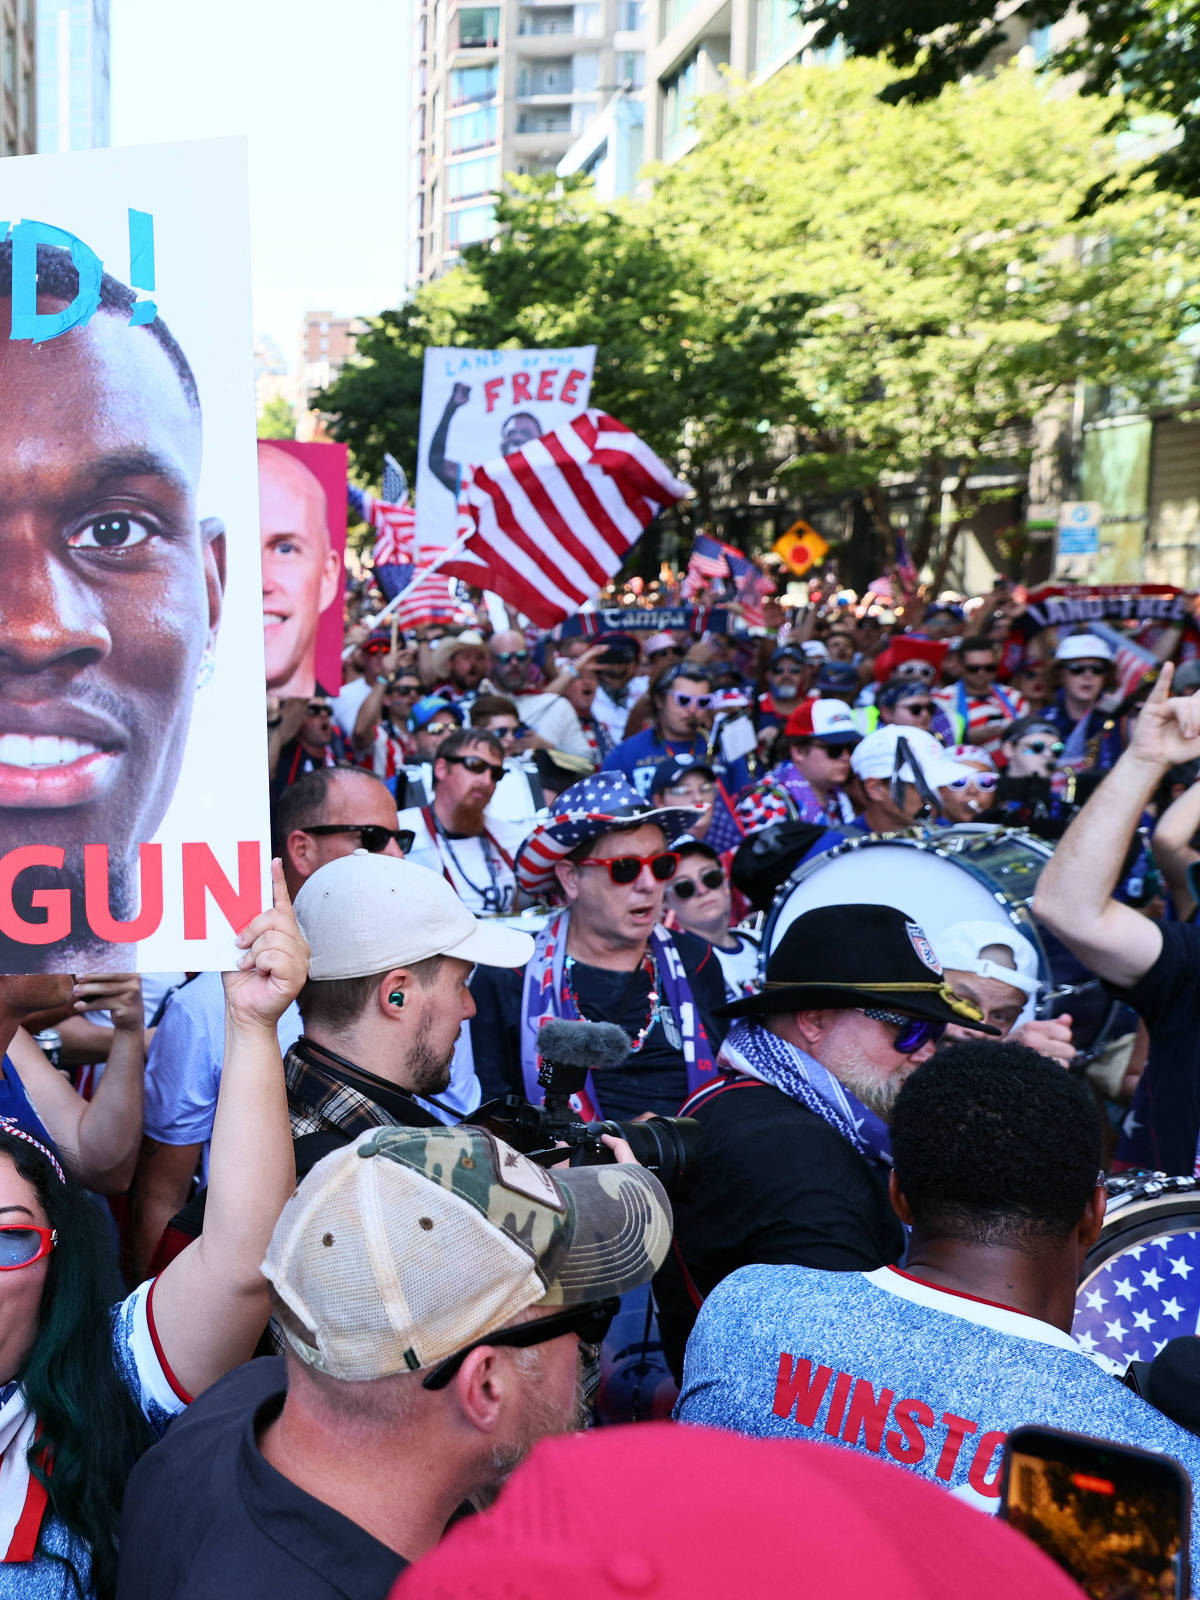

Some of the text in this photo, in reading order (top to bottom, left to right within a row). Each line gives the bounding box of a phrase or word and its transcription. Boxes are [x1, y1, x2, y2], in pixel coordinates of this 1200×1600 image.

[445, 351, 503, 377] LAND
[484, 369, 586, 413] FREE
[772, 1352, 1006, 1498] WINSTO
